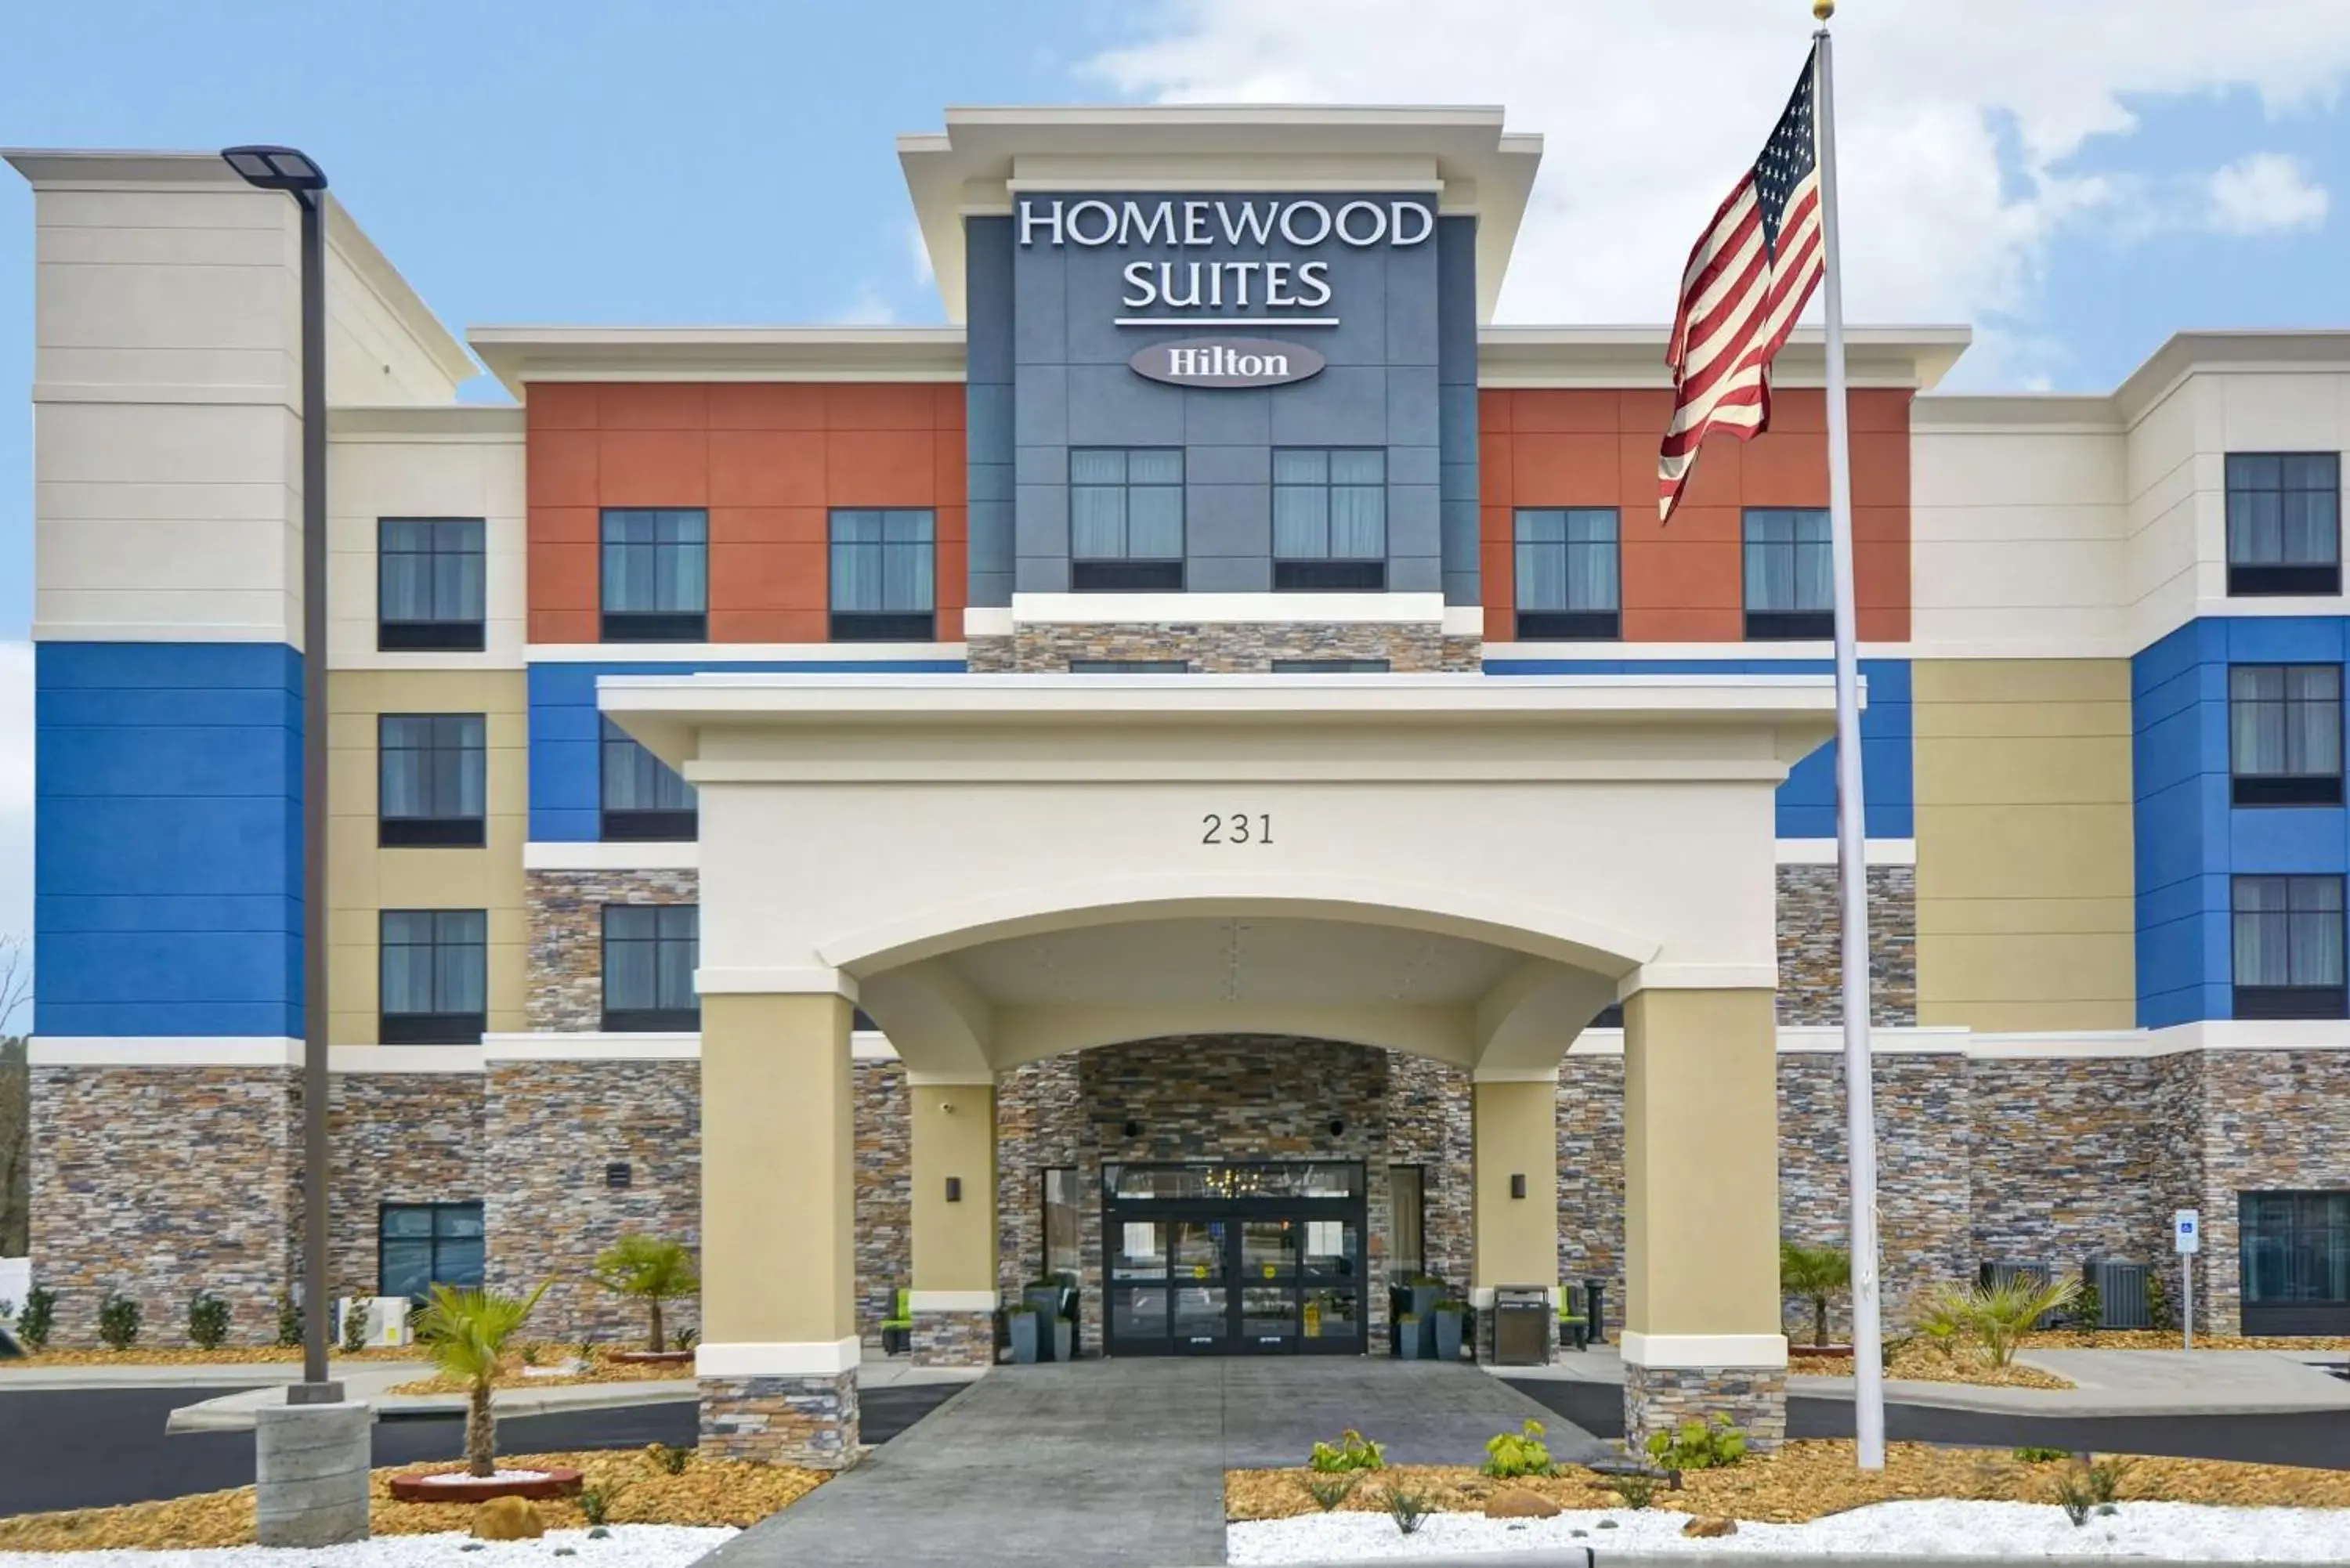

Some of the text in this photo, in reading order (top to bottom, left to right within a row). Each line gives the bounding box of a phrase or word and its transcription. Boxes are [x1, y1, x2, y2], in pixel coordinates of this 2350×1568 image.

[1020, 200, 1433, 245] HOMEWOOD
[1123, 262, 1331, 306] SUITES
[1168, 345, 1289, 377] Hilton
[1202, 814, 1273, 844] 231
